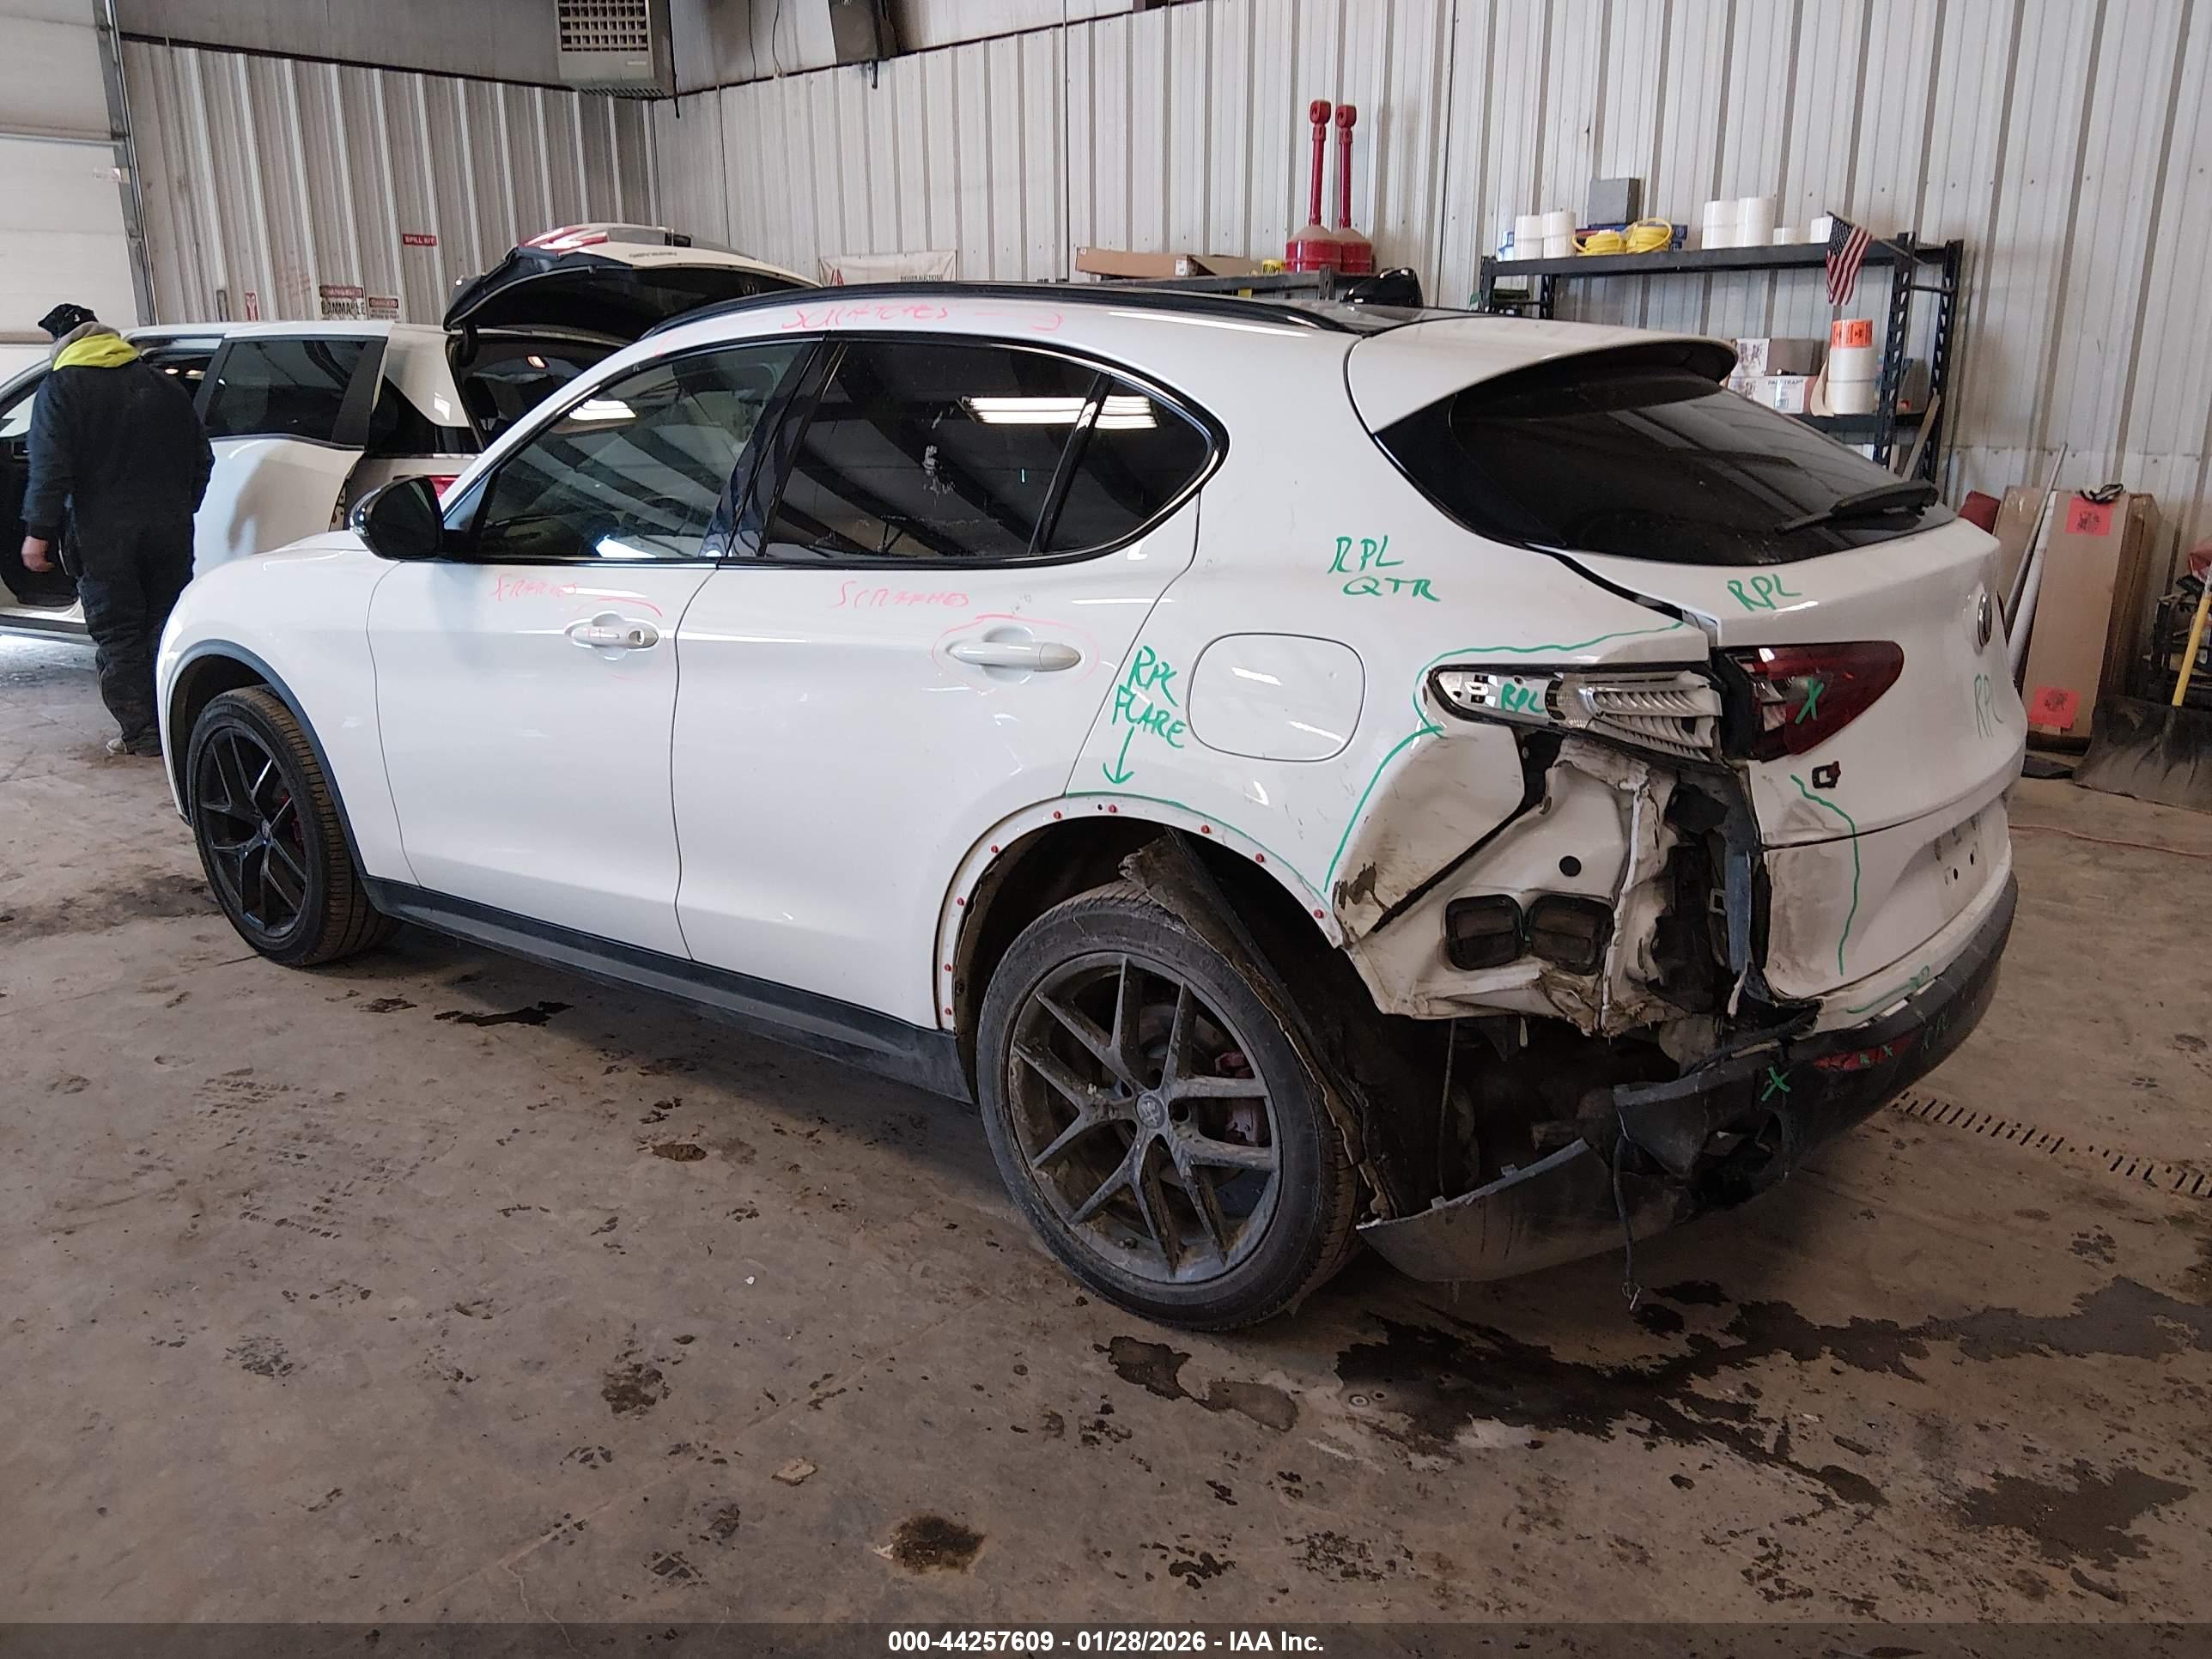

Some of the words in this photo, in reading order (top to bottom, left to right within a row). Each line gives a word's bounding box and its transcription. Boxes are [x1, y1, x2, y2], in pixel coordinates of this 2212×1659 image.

[404, 235, 423, 244] SPILL
[321, 301, 365, 315] AMMALE
[1328, 534, 1404, 574] RPL
[1343, 575, 1441, 602] QTR
[1727, 574, 1802, 611] RPL
[1500, 682, 1545, 714] RPL
[1973, 673, 2004, 738] RPL
